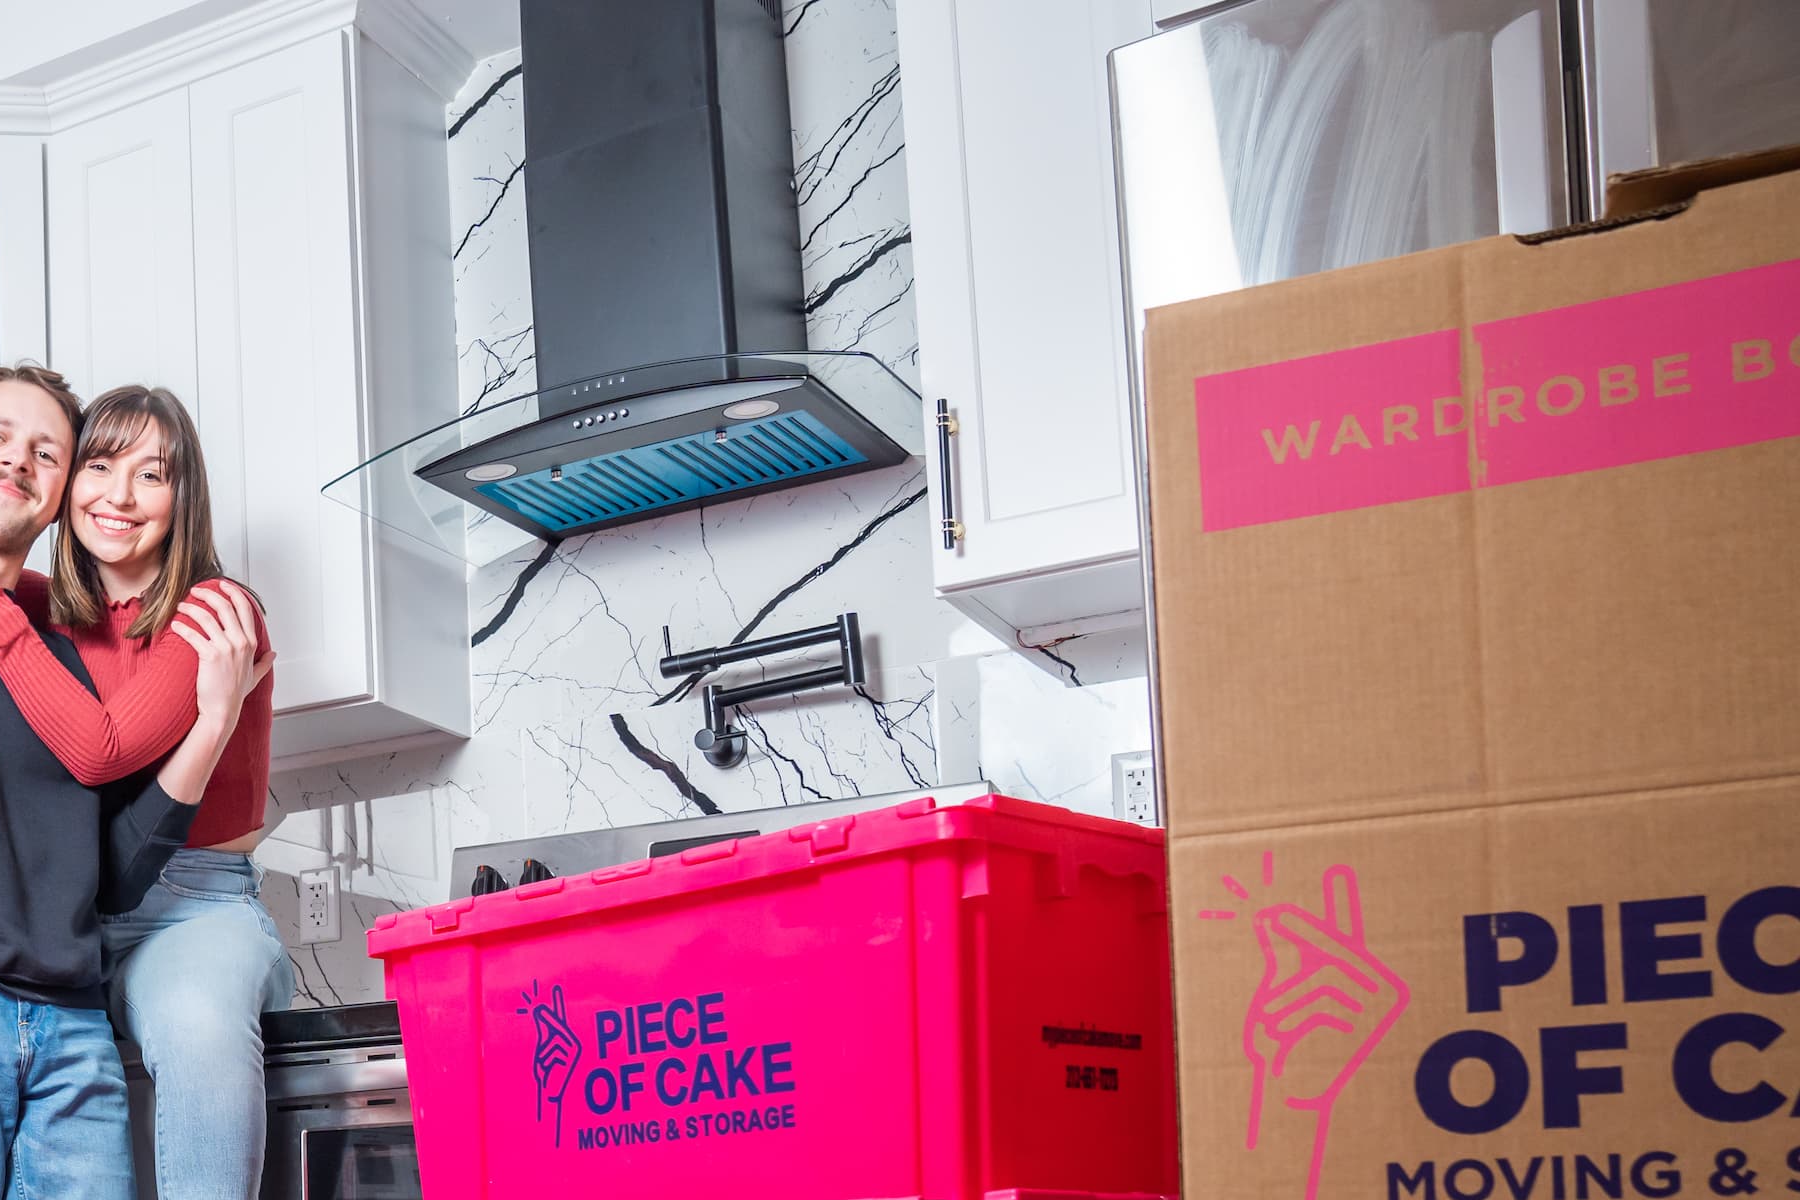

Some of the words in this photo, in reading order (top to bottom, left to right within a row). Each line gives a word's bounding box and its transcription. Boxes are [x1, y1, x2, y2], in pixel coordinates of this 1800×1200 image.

[1261, 352, 1692, 465] WARDROBE
[596, 992, 728, 1059] PIECE
[584, 1062, 645, 1115] OF
[655, 1042, 795, 1107] CAKE
[1414, 1022, 1628, 1135] OF
[578, 1120, 660, 1150] MOVING
[666, 1118, 680, 1140] &
[686, 1104, 796, 1138] STORAGE
[1708, 1147, 1758, 1197] &
